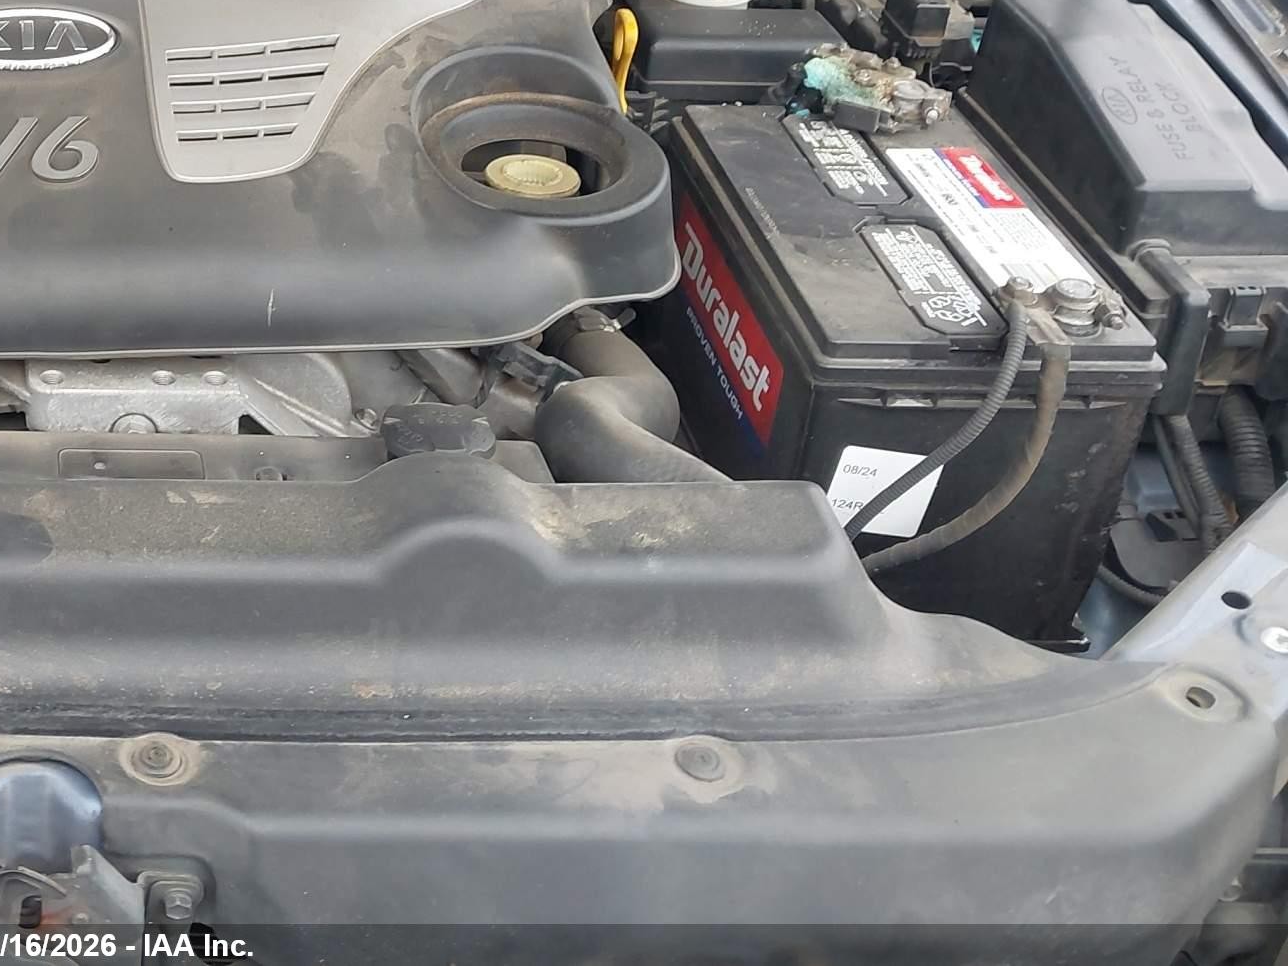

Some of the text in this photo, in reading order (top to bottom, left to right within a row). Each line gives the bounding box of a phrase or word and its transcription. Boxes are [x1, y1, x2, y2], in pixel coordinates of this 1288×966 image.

[1108, 56, 1155, 104] RELAY
[1155, 123, 1194, 161] FUSE
[682, 221, 771, 412] Duralast
[686, 307, 744, 421] PROVEN TOUGH
[842, 464, 878, 477] 08/24
